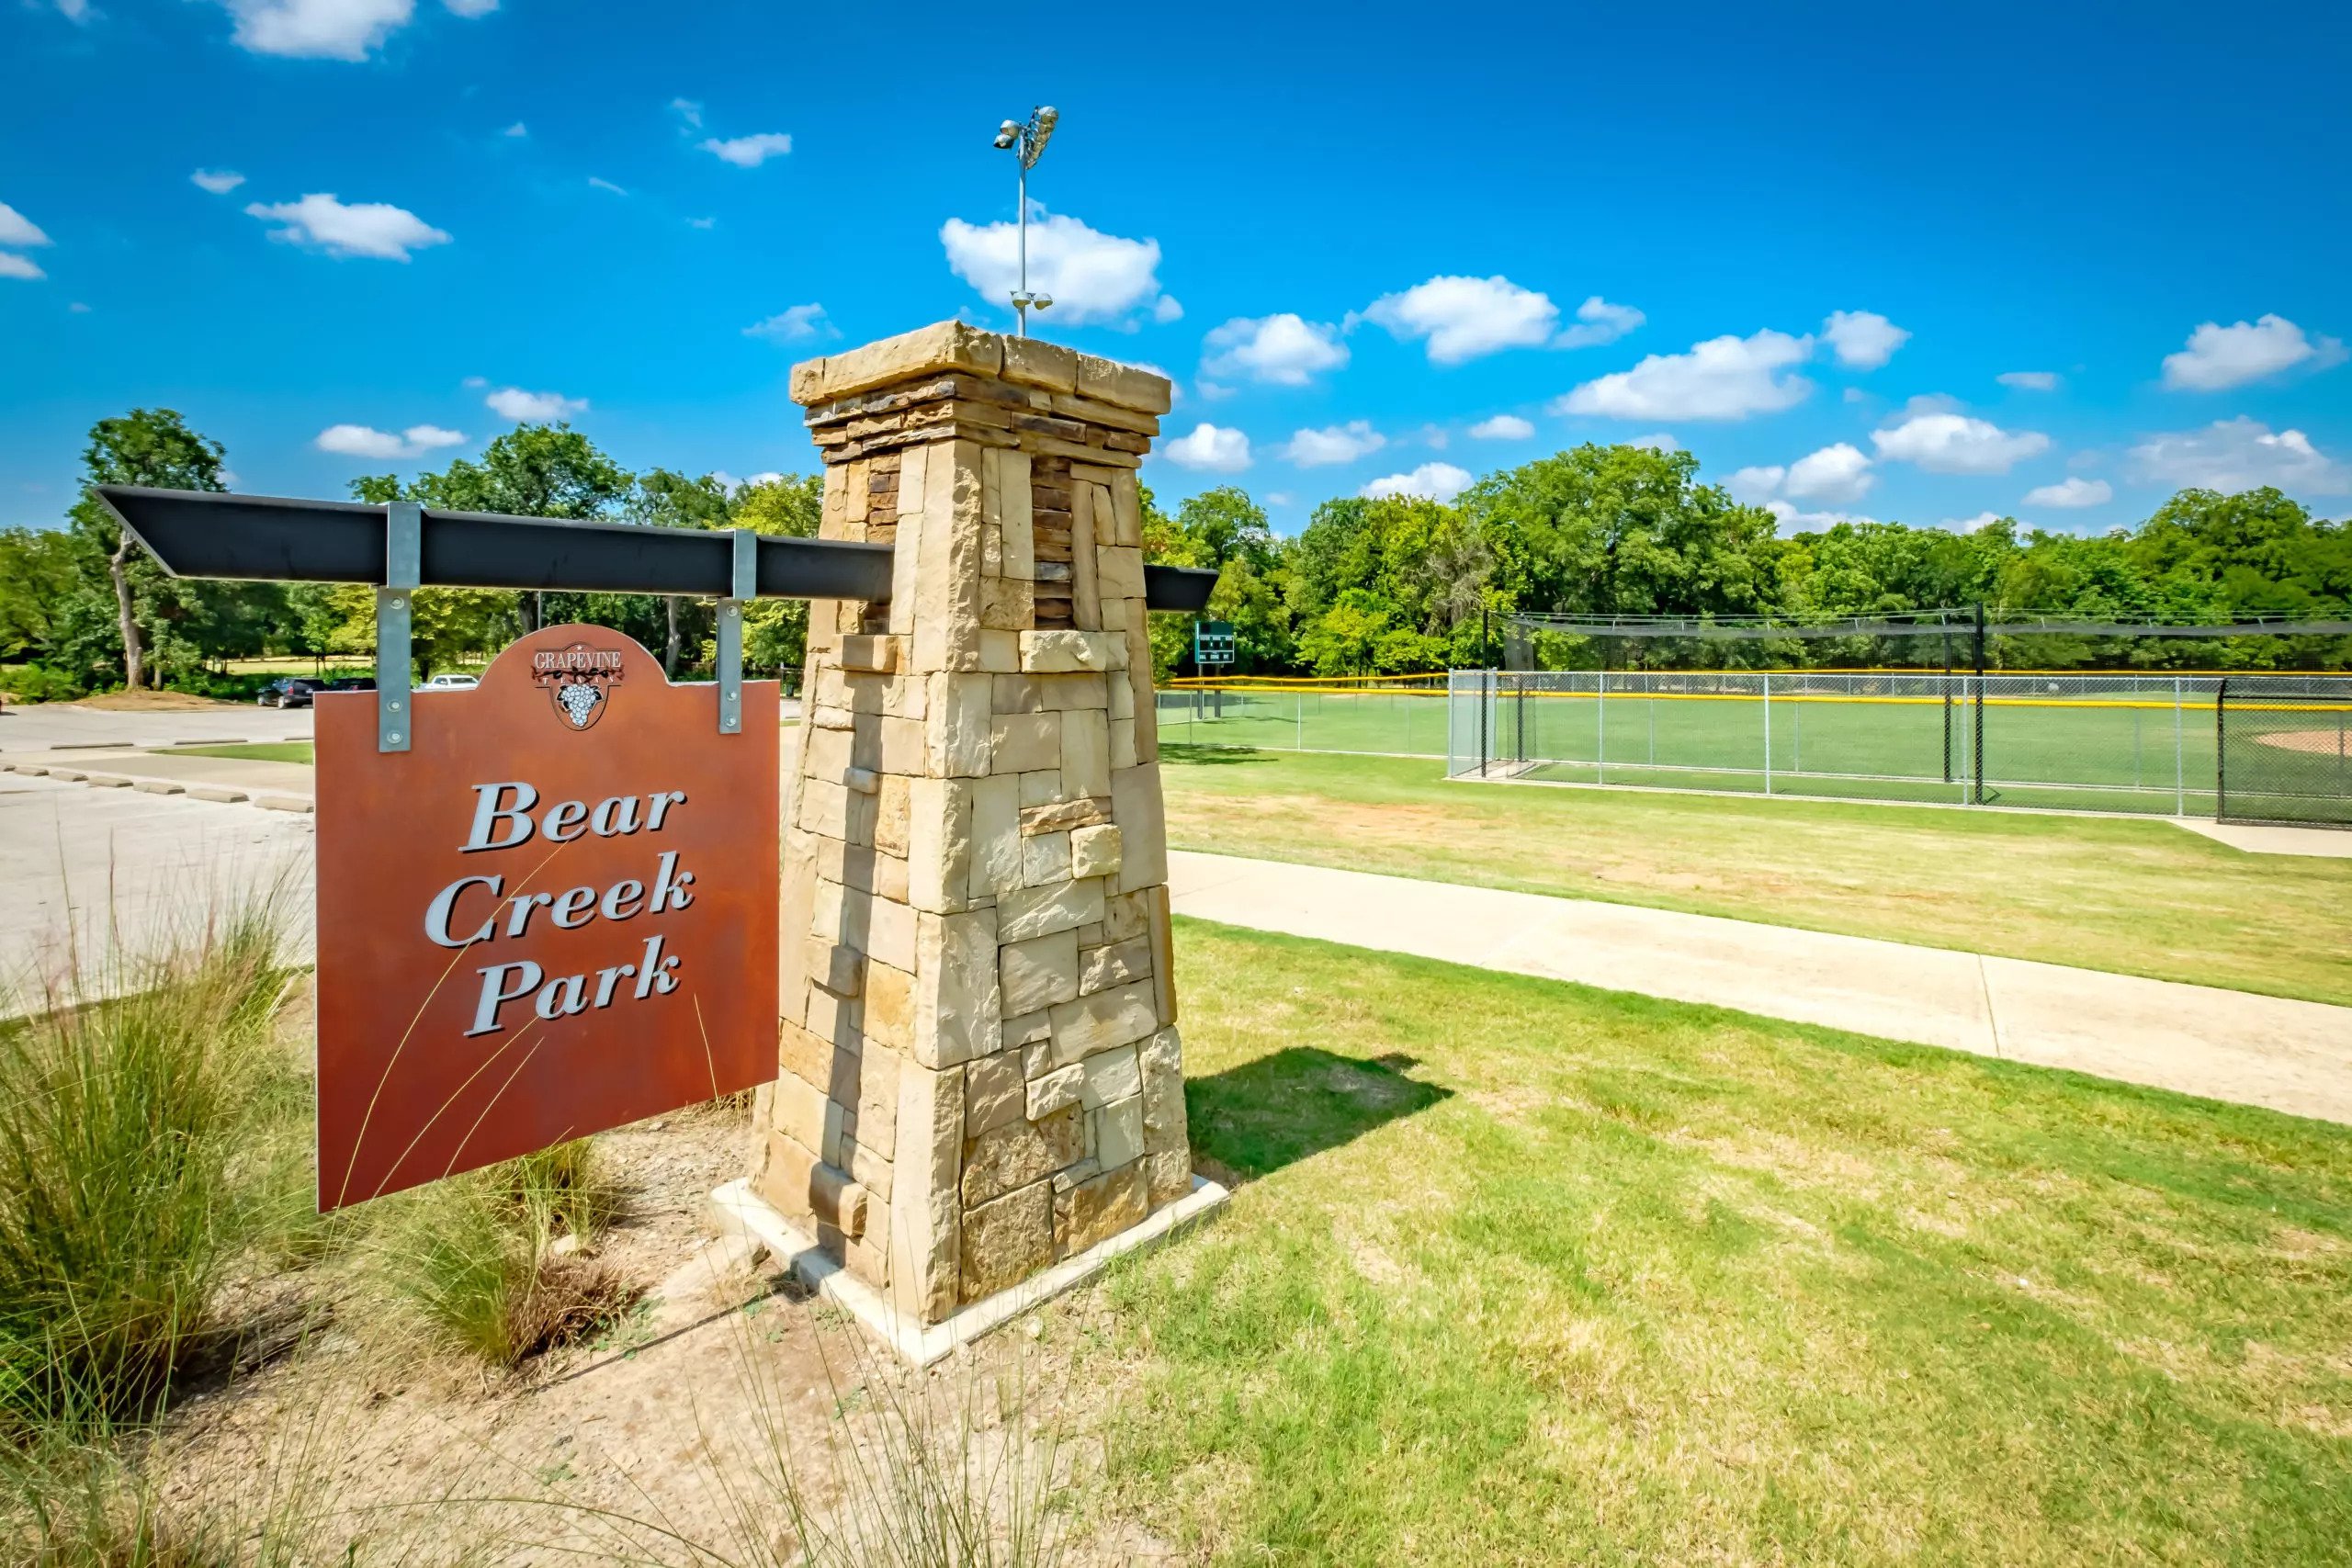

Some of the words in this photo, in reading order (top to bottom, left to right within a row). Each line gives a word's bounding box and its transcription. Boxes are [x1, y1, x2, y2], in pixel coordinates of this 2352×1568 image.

[534, 651, 621, 669] GRAPEVINE
[458, 782, 686, 852] Bear
[424, 851, 695, 947] Creek
[463, 934, 681, 1037] Park
